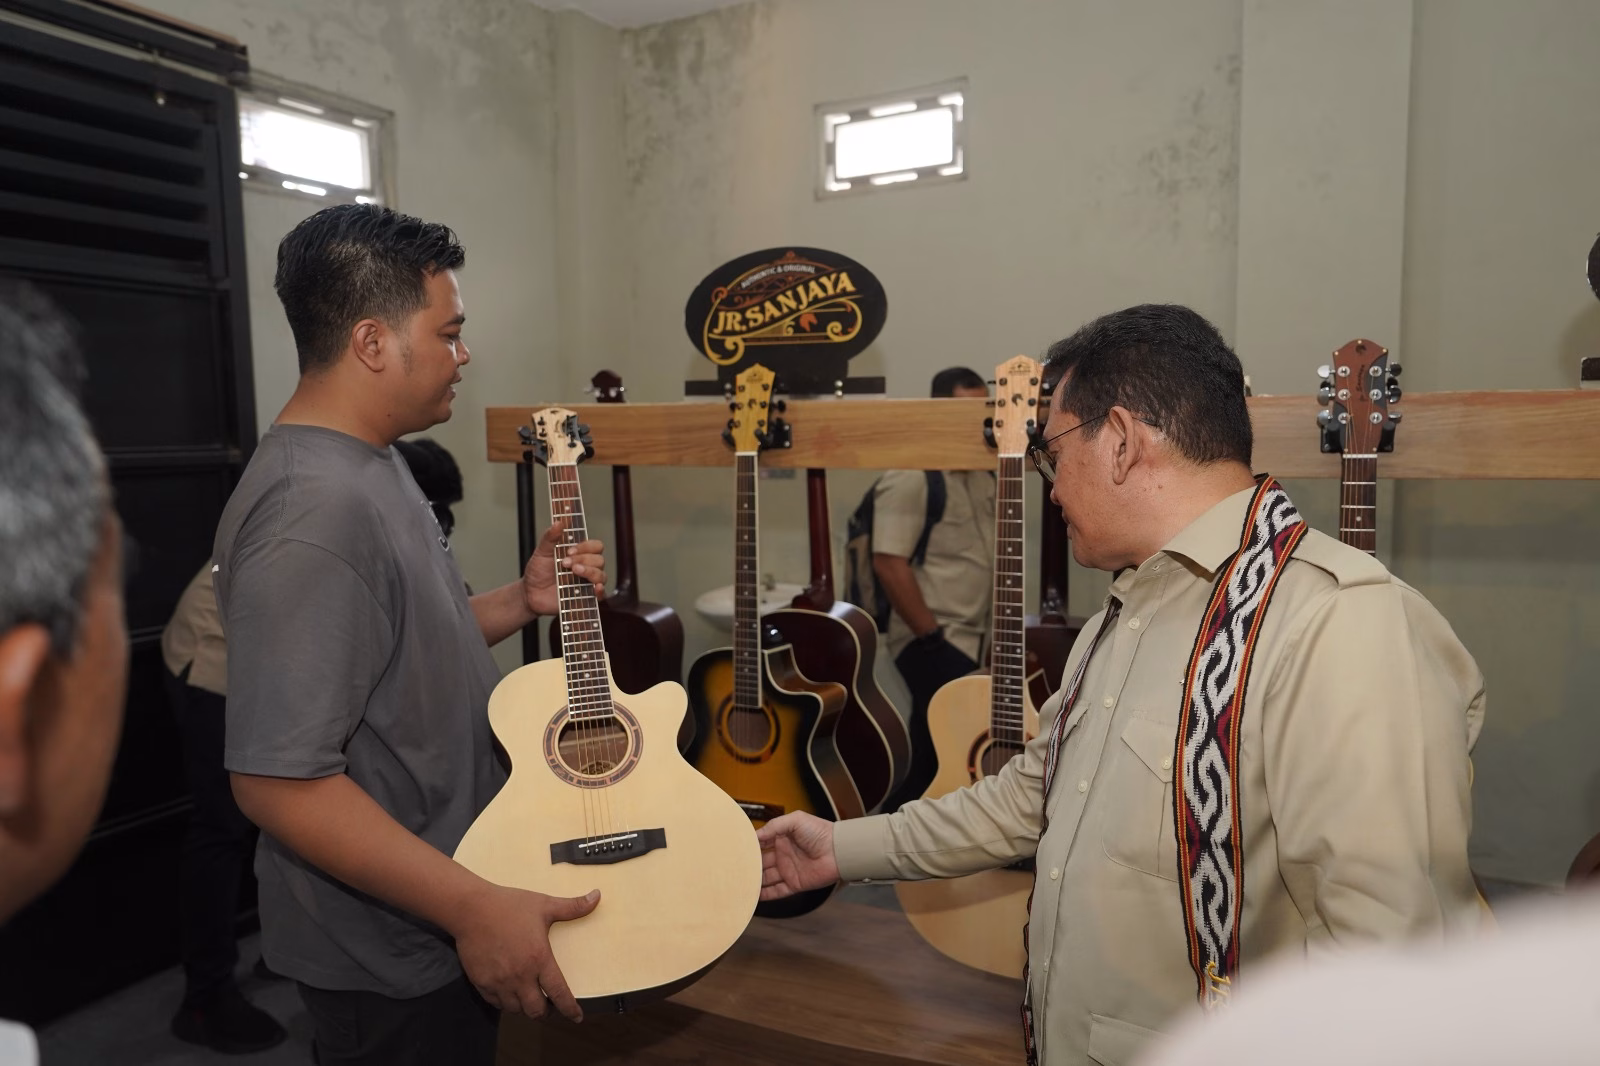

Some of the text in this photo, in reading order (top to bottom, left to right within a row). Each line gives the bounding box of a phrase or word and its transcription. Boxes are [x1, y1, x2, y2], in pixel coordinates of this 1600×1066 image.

[741, 264, 815, 289] AUTHENTIC & ORIGINAL
